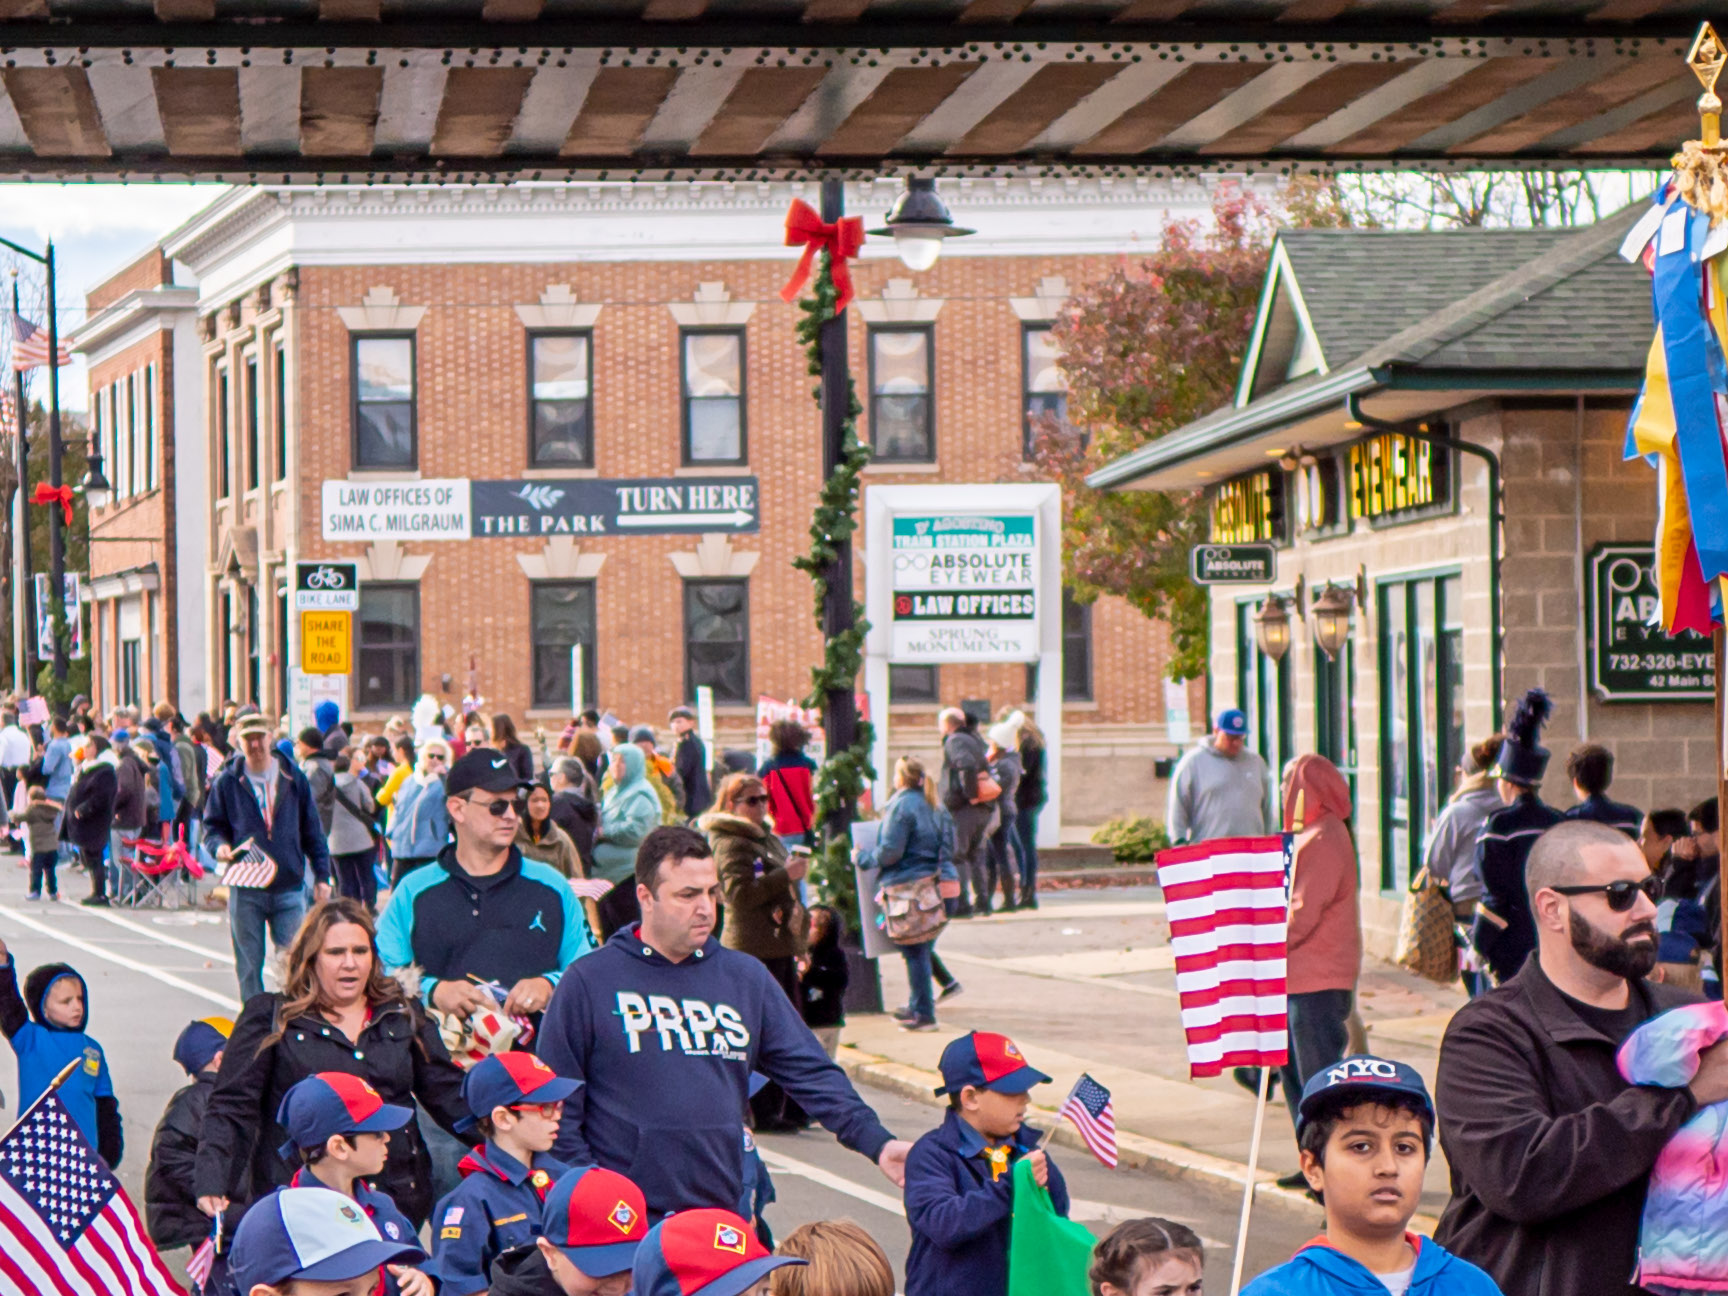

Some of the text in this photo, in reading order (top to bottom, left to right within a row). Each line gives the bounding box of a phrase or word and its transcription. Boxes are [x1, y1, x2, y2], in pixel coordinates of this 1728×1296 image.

[339, 487, 453, 506] LAW OFFICES OF
[616, 485, 754, 512] TURN HERE
[330, 514, 365, 532] SIMA
[386, 513, 464, 533] MILGRAUM
[481, 514, 605, 533] THE PARK
[894, 533, 1033, 549] TRAIN STATION PLAZA
[931, 554, 1032, 568] ABSOLUTE
[931, 569, 1032, 584] EYEWEAR
[299, 593, 352, 605] BIKE LANE
[913, 594, 1034, 615] LAW OFFICES
[307, 620, 344, 632] SHARE
[929, 628, 998, 640] SPRUNG
[316, 636, 336, 648] THE
[908, 640, 1022, 653] MONUMENTS
[311, 653, 341, 664] ROAD
[615, 990, 750, 1054] PRPS
[1327, 1059, 1396, 1087] NYC
